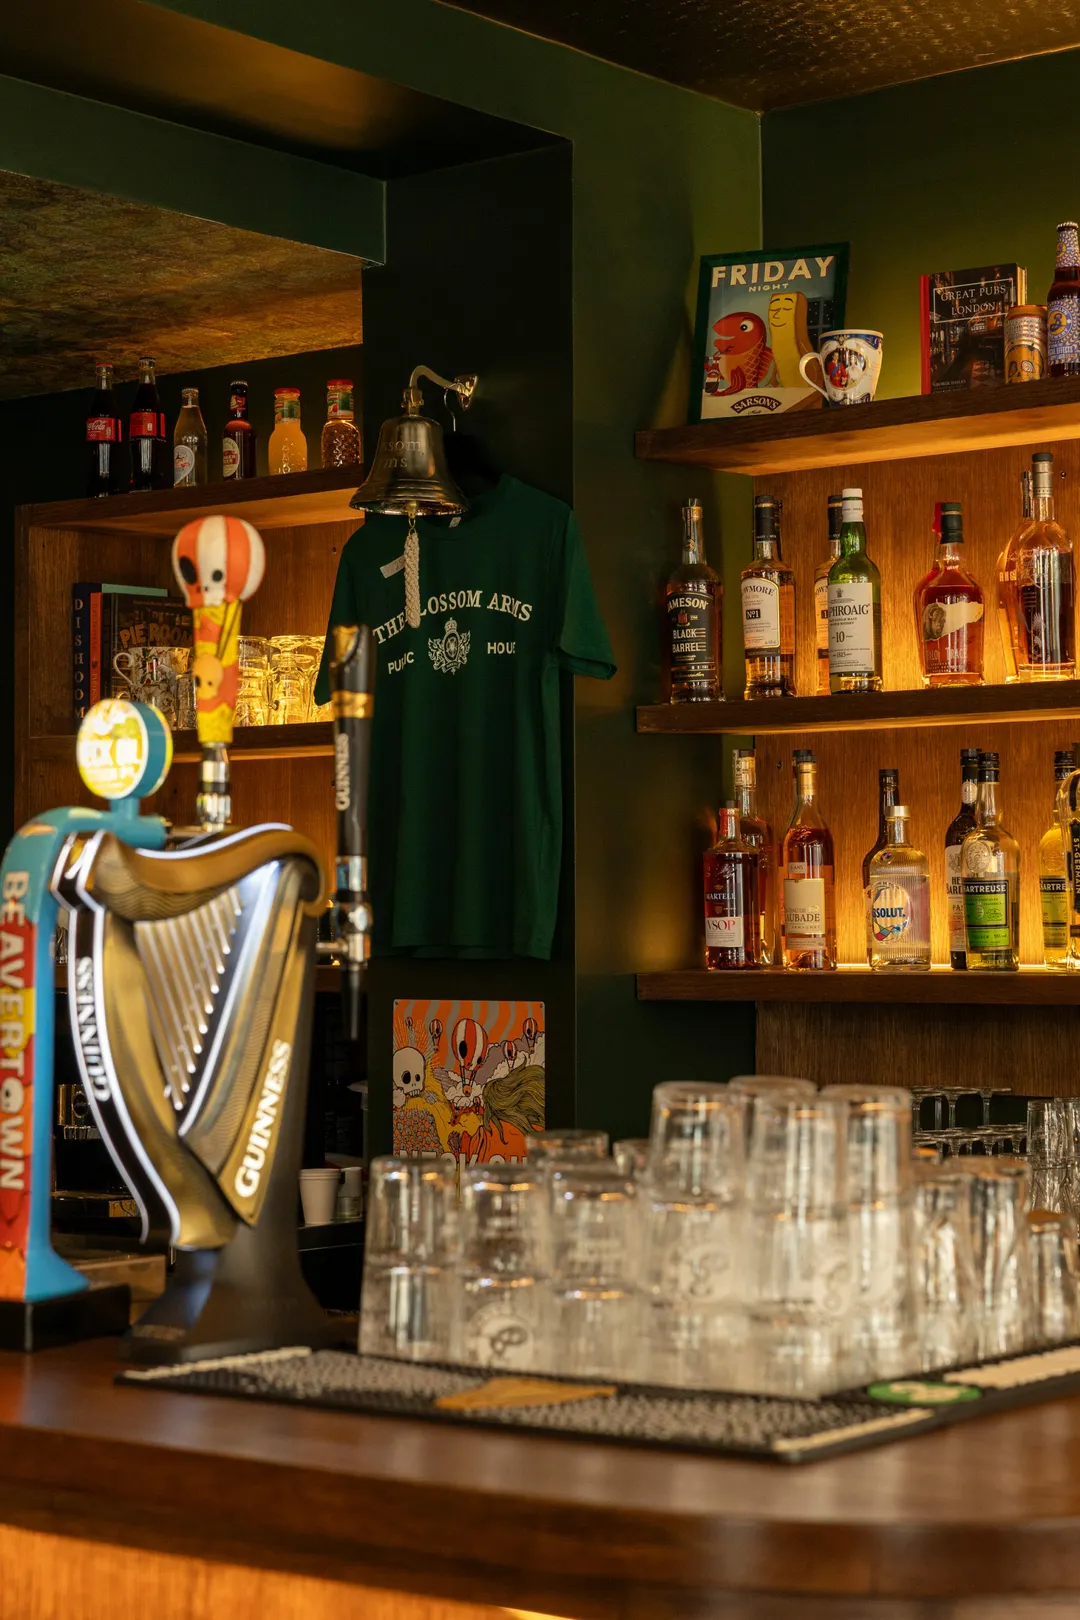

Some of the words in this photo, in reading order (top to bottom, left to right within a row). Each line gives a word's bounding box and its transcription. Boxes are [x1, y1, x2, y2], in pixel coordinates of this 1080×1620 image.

[711, 255, 834, 288] FRIDAY
[748, 283, 789, 292] NIGHT
[940, 288, 976, 302] GREAT
[979, 284, 1007, 297] PUBS
[951, 302, 997, 316] LONDON
[734, 396, 780, 411] SARSON'S
[372, 611, 407, 645] THE
[416, 589, 483, 617] LOSSOM
[486, 592, 533, 622] ARMS
[828, 603, 869, 617] PHROAIG
[119, 623, 146, 649] PIE
[673, 628, 698, 640] BLACK
[836, 630, 846, 643] 10
[672, 642, 701, 654] BARREL
[707, 919, 736, 931] VSOP
[75, 956, 112, 1102] GUINNESS
[234, 1038, 291, 1198] GUINNESS
